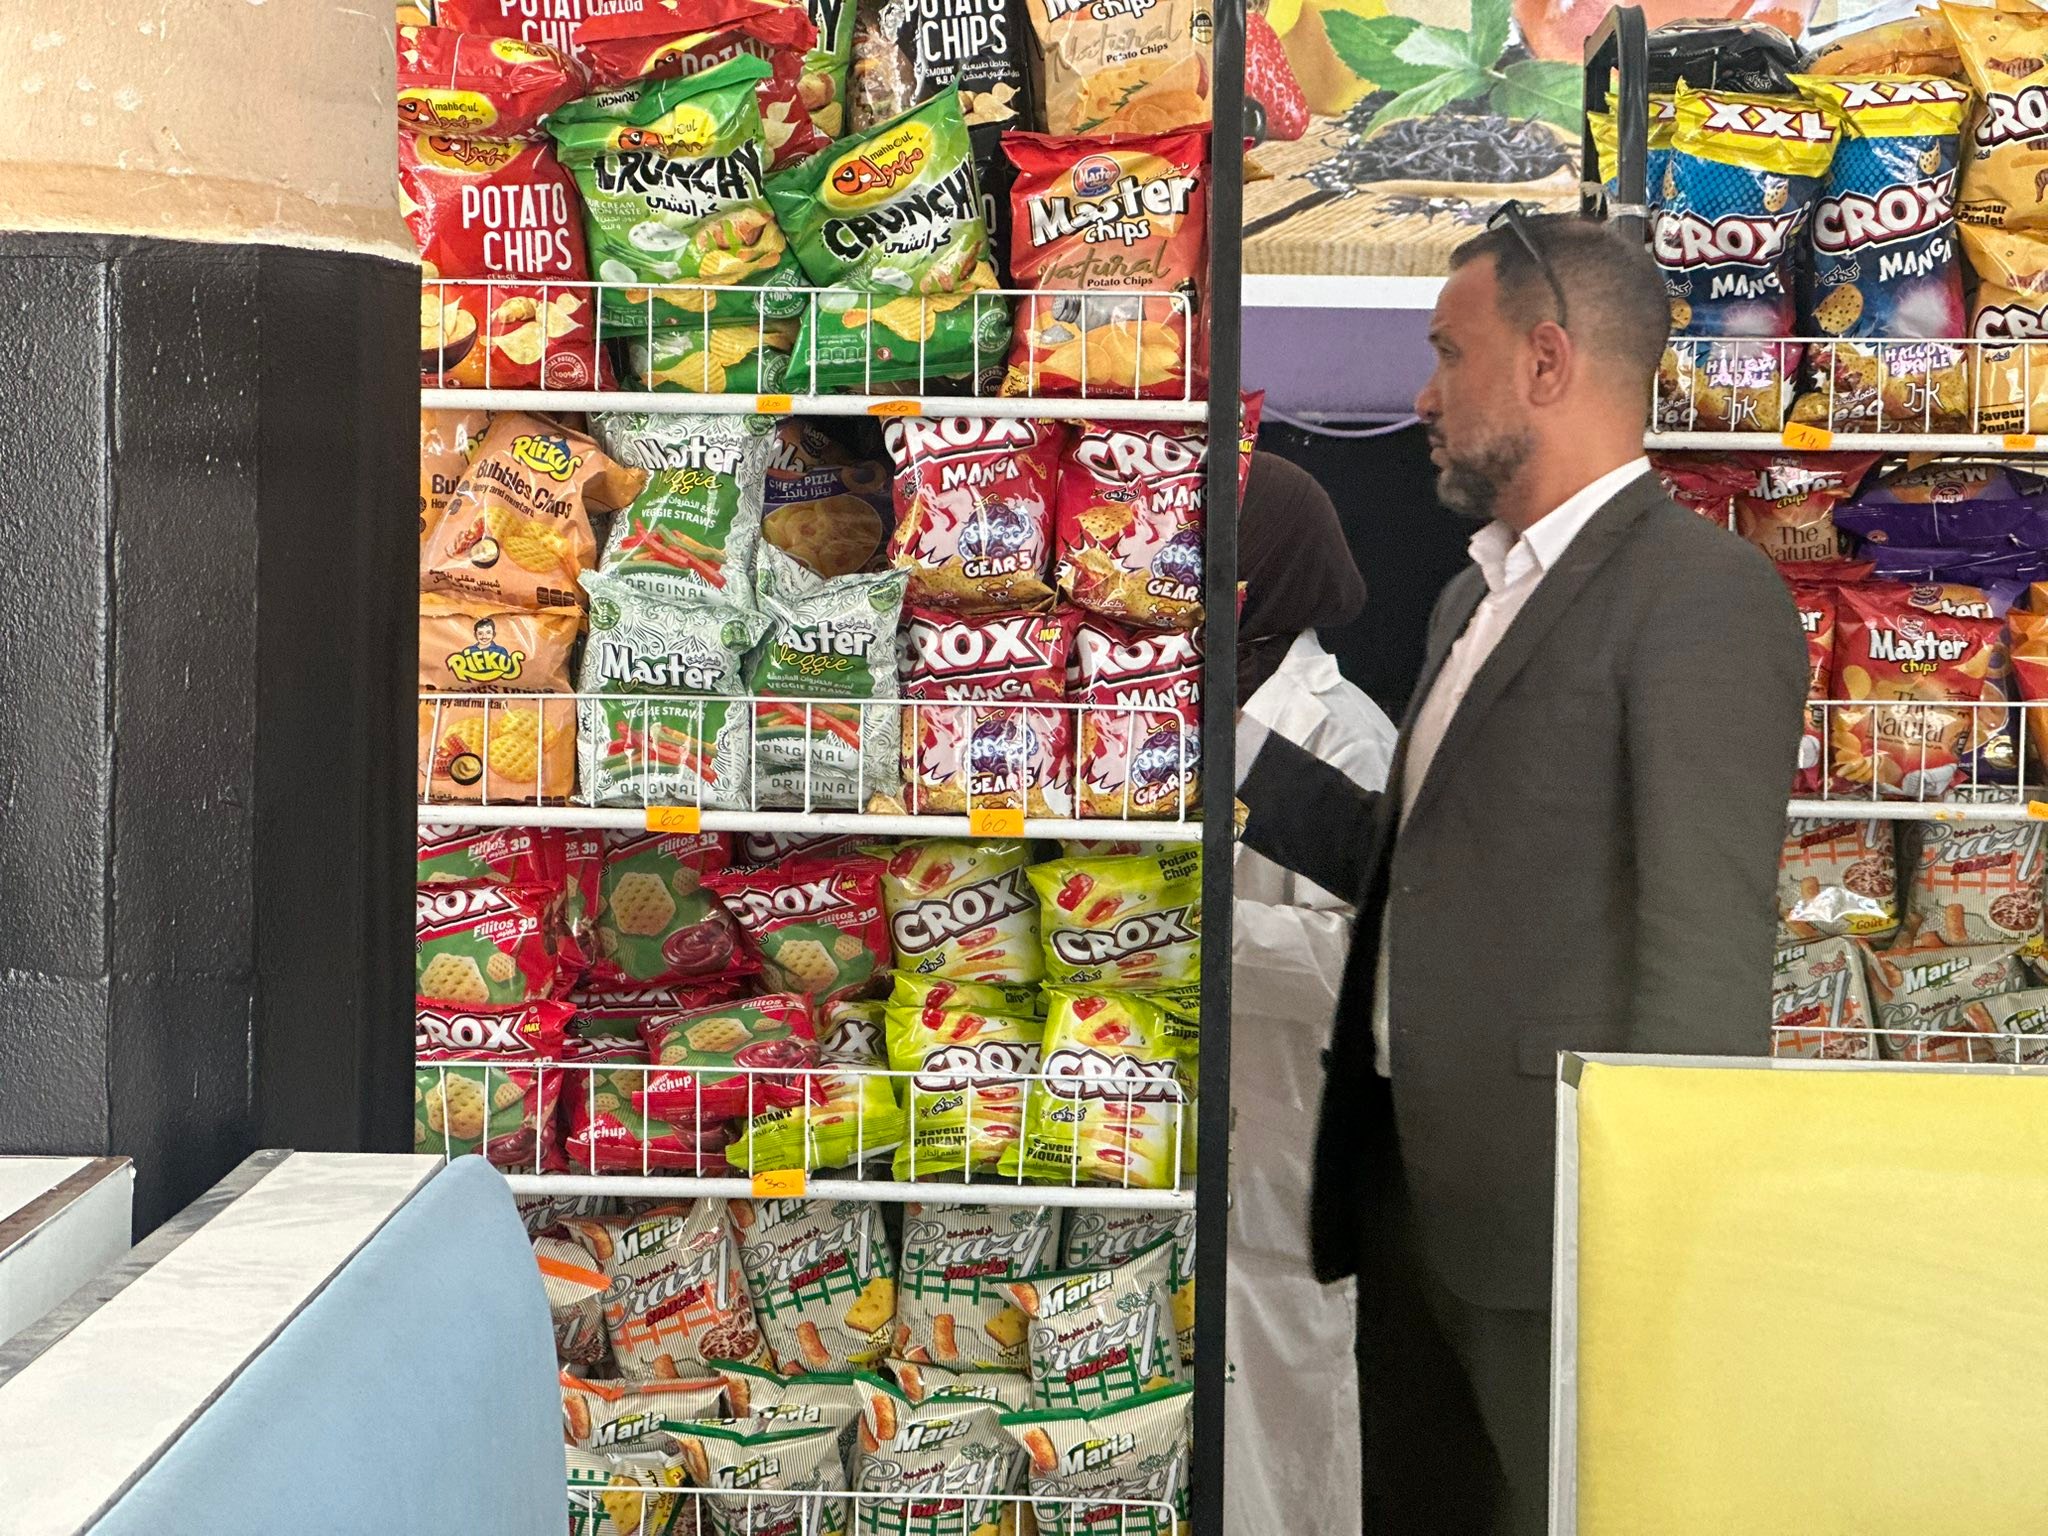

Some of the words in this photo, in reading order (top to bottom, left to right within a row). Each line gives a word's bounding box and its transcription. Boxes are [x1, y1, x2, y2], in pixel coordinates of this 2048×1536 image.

[922, 14, 1007, 62] CHIPS
[1140, 43, 1169, 56] Chips
[1834, 79, 1968, 110] XXL
[1704, 99, 1837, 143] XXL
[869, 131, 914, 161] mahboul
[462, 182, 568, 229] POTATO
[1813, 172, 1958, 250] CROX
[1084, 219, 1151, 246] chips
[483, 228, 572, 273] CHIPS
[1878, 237, 1952, 283] MANGA
[1087, 278, 1120, 288] Potato
[1123, 275, 1153, 287] Chips
[634, 435, 745, 475] Master
[884, 417, 1033, 467] CROX
[476, 458, 532, 500] Bubbles
[804, 472, 838, 486] PIZZA
[941, 456, 1020, 491] MANGA
[1151, 485, 1204, 514] MAN
[641, 507, 672, 519] VEGGIE
[674, 510, 717, 529] STRAWS
[1776, 526, 1819, 546] The
[963, 554, 1017, 578] GEAR
[780, 620, 877, 656] aster
[1039, 626, 1062, 643] MAX
[1868, 627, 1969, 662] Master
[601, 642, 726, 691] Master
[773, 643, 854, 676] Veggie
[1901, 659, 1939, 676] chips
[767, 682, 806, 691] VEGGIE
[945, 678, 1035, 702] MANGA
[1116, 679, 1200, 716] MANGA
[761, 744, 845, 762] ORIGNAL
[620, 782, 697, 797] ORGINAL
[970, 773, 1021, 794] GEAR
[660, 809, 685, 826] 60
[981, 813, 1008, 833] 60
[510, 836, 531, 851] 3D
[581, 842, 599, 855] 3D
[657, 834, 696, 855] Filitos
[699, 832, 720, 847] 3D
[1158, 850, 1199, 870] Potato
[1163, 861, 1199, 882] Chips
[1950, 852, 2013, 875] snacks
[723, 877, 846, 928] CROX
[816, 911, 855, 925] Filitos
[858, 906, 878, 921] 3D
[893, 870, 1029, 952] CROX
[473, 918, 515, 939] Filitos
[518, 916, 538, 932] 3D
[1055, 909, 1193, 964] CROX
[1905, 956, 1971, 994] Maria
[522, 1022, 541, 1033] MAX
[1164, 1025, 1199, 1039] Chips
[913, 1044, 1042, 1091] CROX
[1045, 1052, 1182, 1102] CROX
[918, 1126, 965, 1138] Saveur
[616, 1215, 684, 1266] Maria
[742, 1207, 874, 1299] Crazy
[902, 1218, 1051, 1278] Crazy
[602, 1238, 731, 1331] Crazy
[788, 1250, 848, 1294] snacks
[942, 1257, 1009, 1282] snacks
[645, 1283, 706, 1328] snacks
[1040, 1270, 1114, 1319] Maria
[1030, 1302, 1160, 1383] Crazy
[1065, 1347, 1129, 1386] snacks
[591, 1411, 667, 1449] Maria
[894, 1418, 972, 1453] Maria
[1062, 1431, 1136, 1477] Maria
[711, 1455, 781, 1491] Maria
